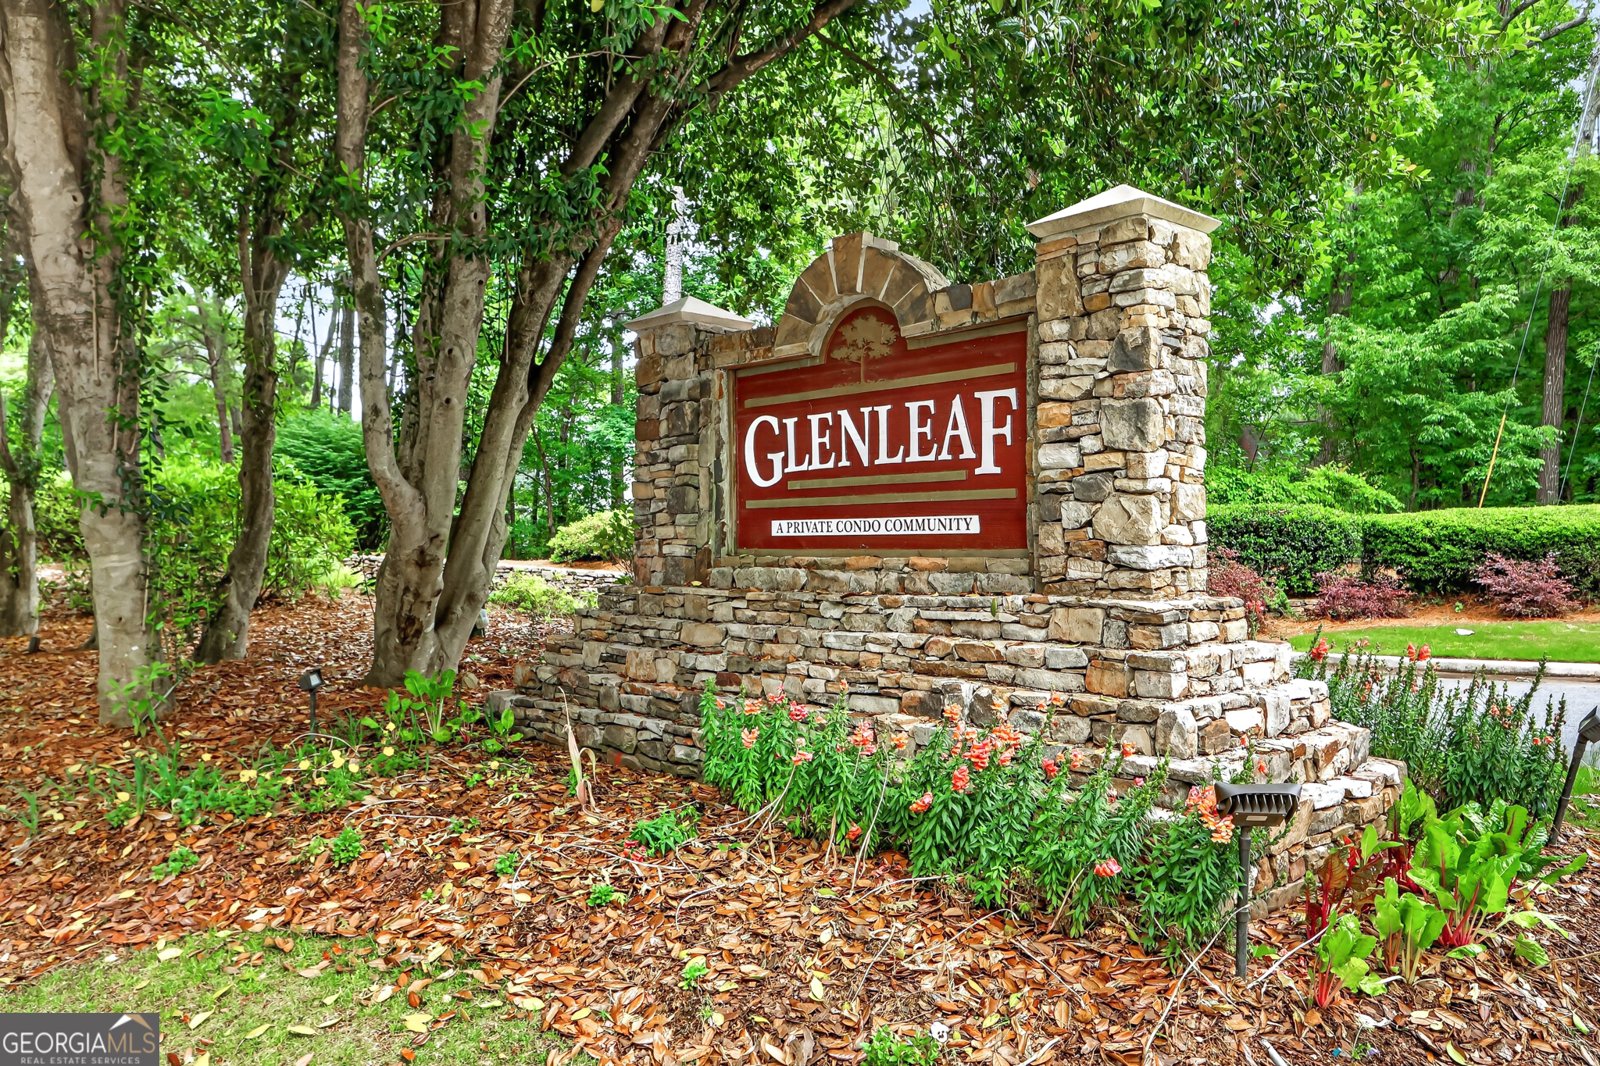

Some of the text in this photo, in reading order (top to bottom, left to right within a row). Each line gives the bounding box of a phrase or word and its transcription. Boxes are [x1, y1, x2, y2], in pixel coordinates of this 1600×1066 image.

[744, 387, 1018, 488] GLENLEAF
[776, 517, 973, 534] A PRIVATE CONDO COMMUNITY
